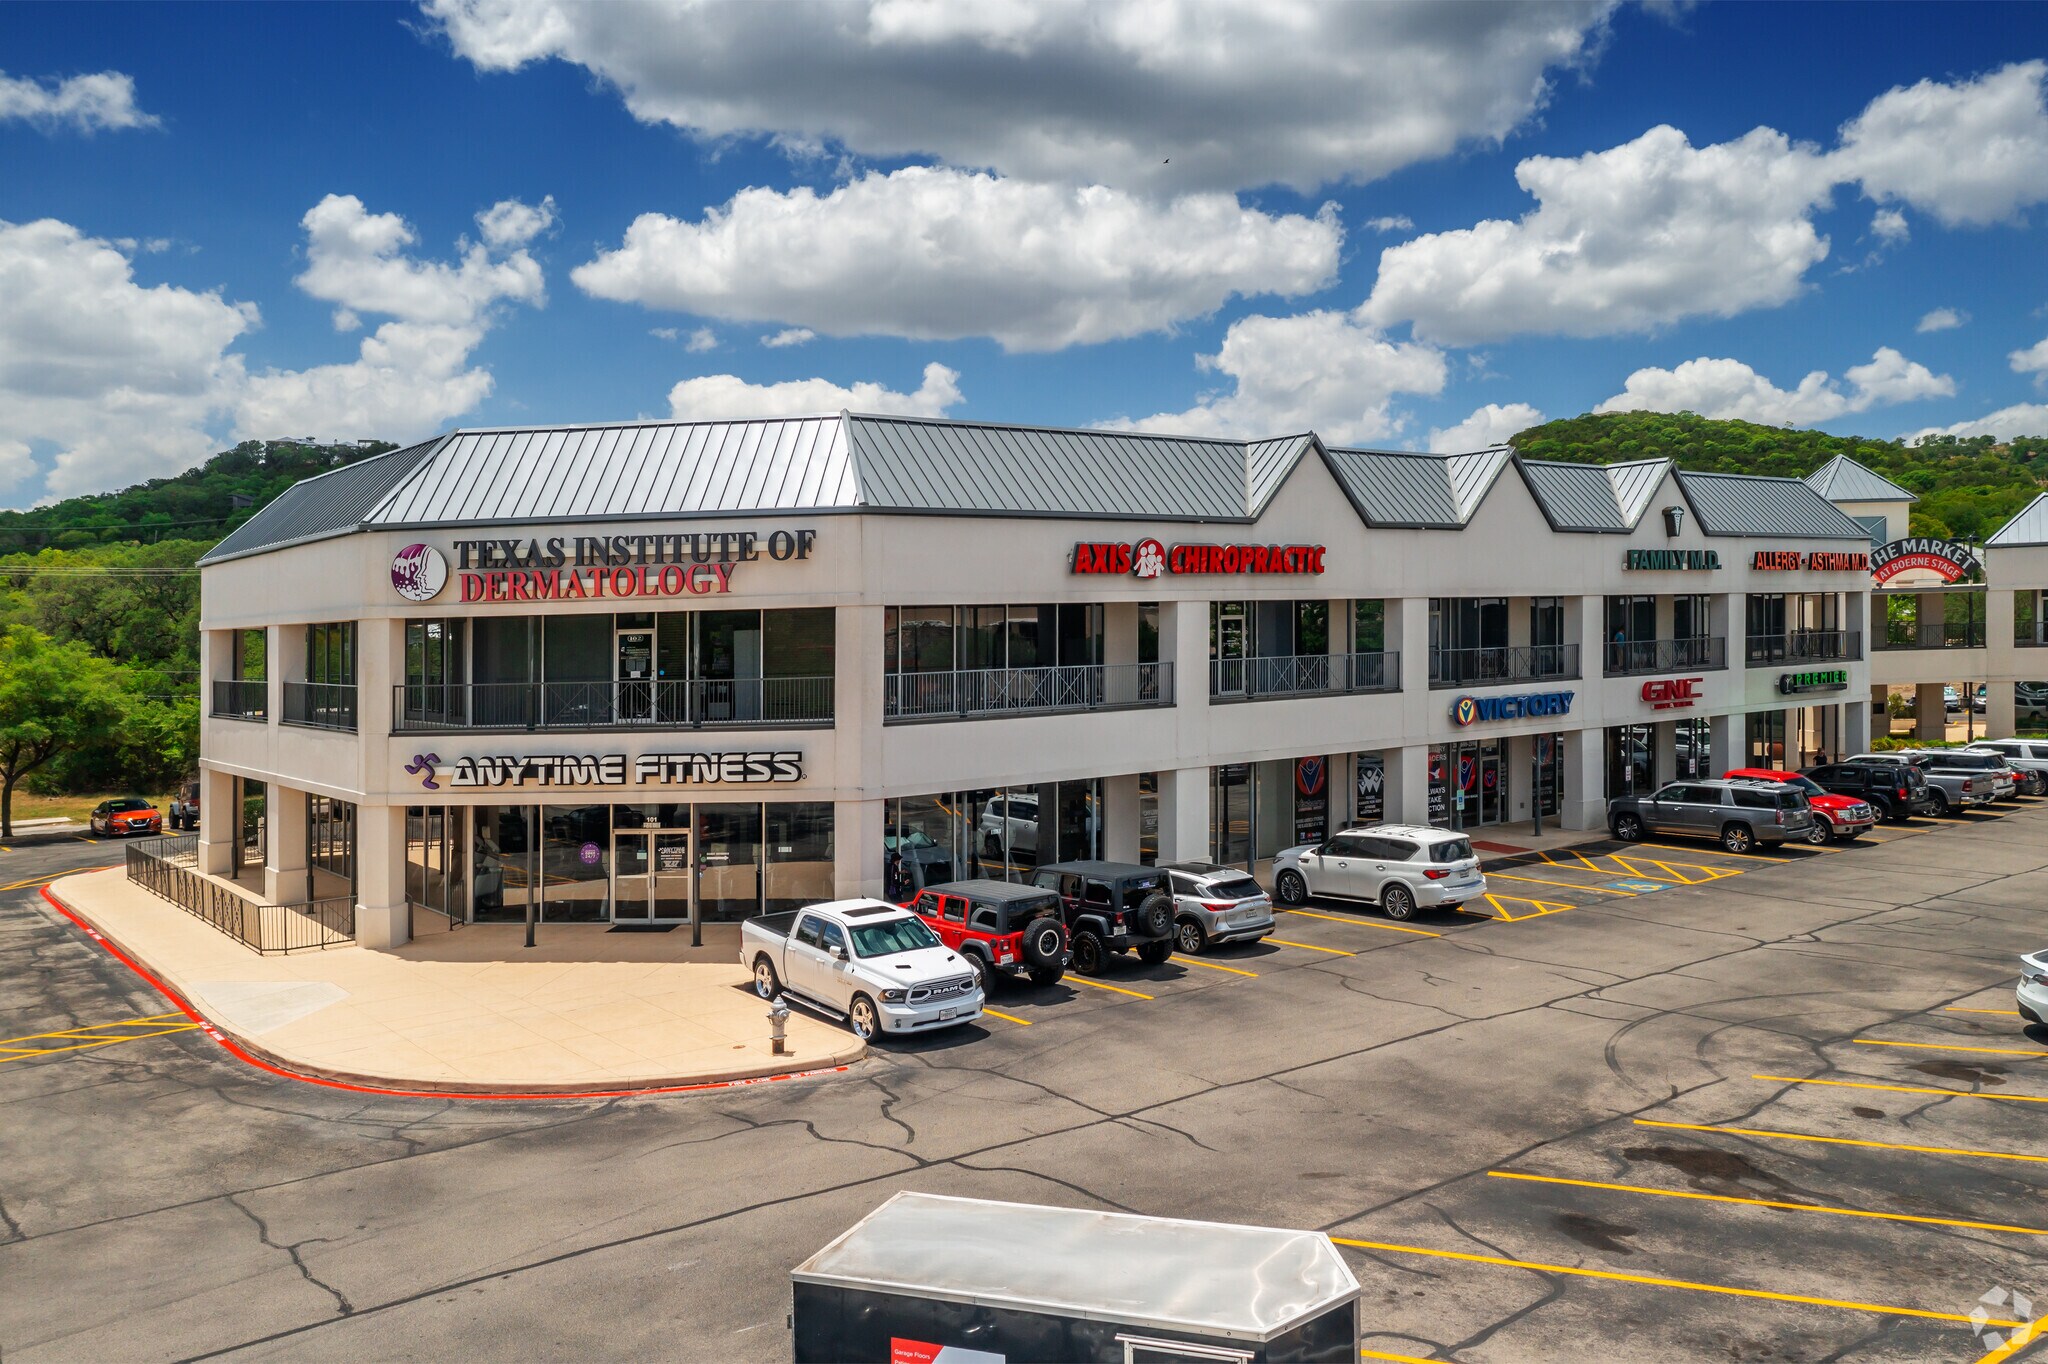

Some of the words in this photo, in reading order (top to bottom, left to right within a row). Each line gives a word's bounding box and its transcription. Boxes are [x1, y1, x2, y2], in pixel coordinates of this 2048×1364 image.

[454, 537, 566, 570] TEXAS
[573, 532, 759, 566] INSTITUTE
[768, 529, 817, 561] OF
[1074, 543, 1132, 574] AXIS
[1170, 545, 1327, 575] CHIROPRACTIC
[1627, 550, 1688, 571] FAMILY
[1690, 550, 1722, 570] M.D.
[1753, 551, 1801, 571] ALLERGY
[1808, 552, 1850, 571] ASTHMA
[1870, 543, 1899, 571] THE
[1901, 538, 1976, 570] MARKET
[1879, 567, 1892, 580] AT
[1891, 557, 1930, 571] BOERNE
[1930, 558, 1960, 579] STAGE
[459, 562, 738, 603] DERMATOLOGY
[1641, 677, 1704, 701] GNC
[1793, 670, 1848, 686] PREMIER
[1476, 691, 1575, 721] VICTORY
[450, 754, 627, 787] ANYTIME
[634, 751, 802, 784] FITNESS
[933, 985, 960, 995] RAM
[894, 1348, 914, 1358] Garage
[914, 1351, 931, 1360] Floors
